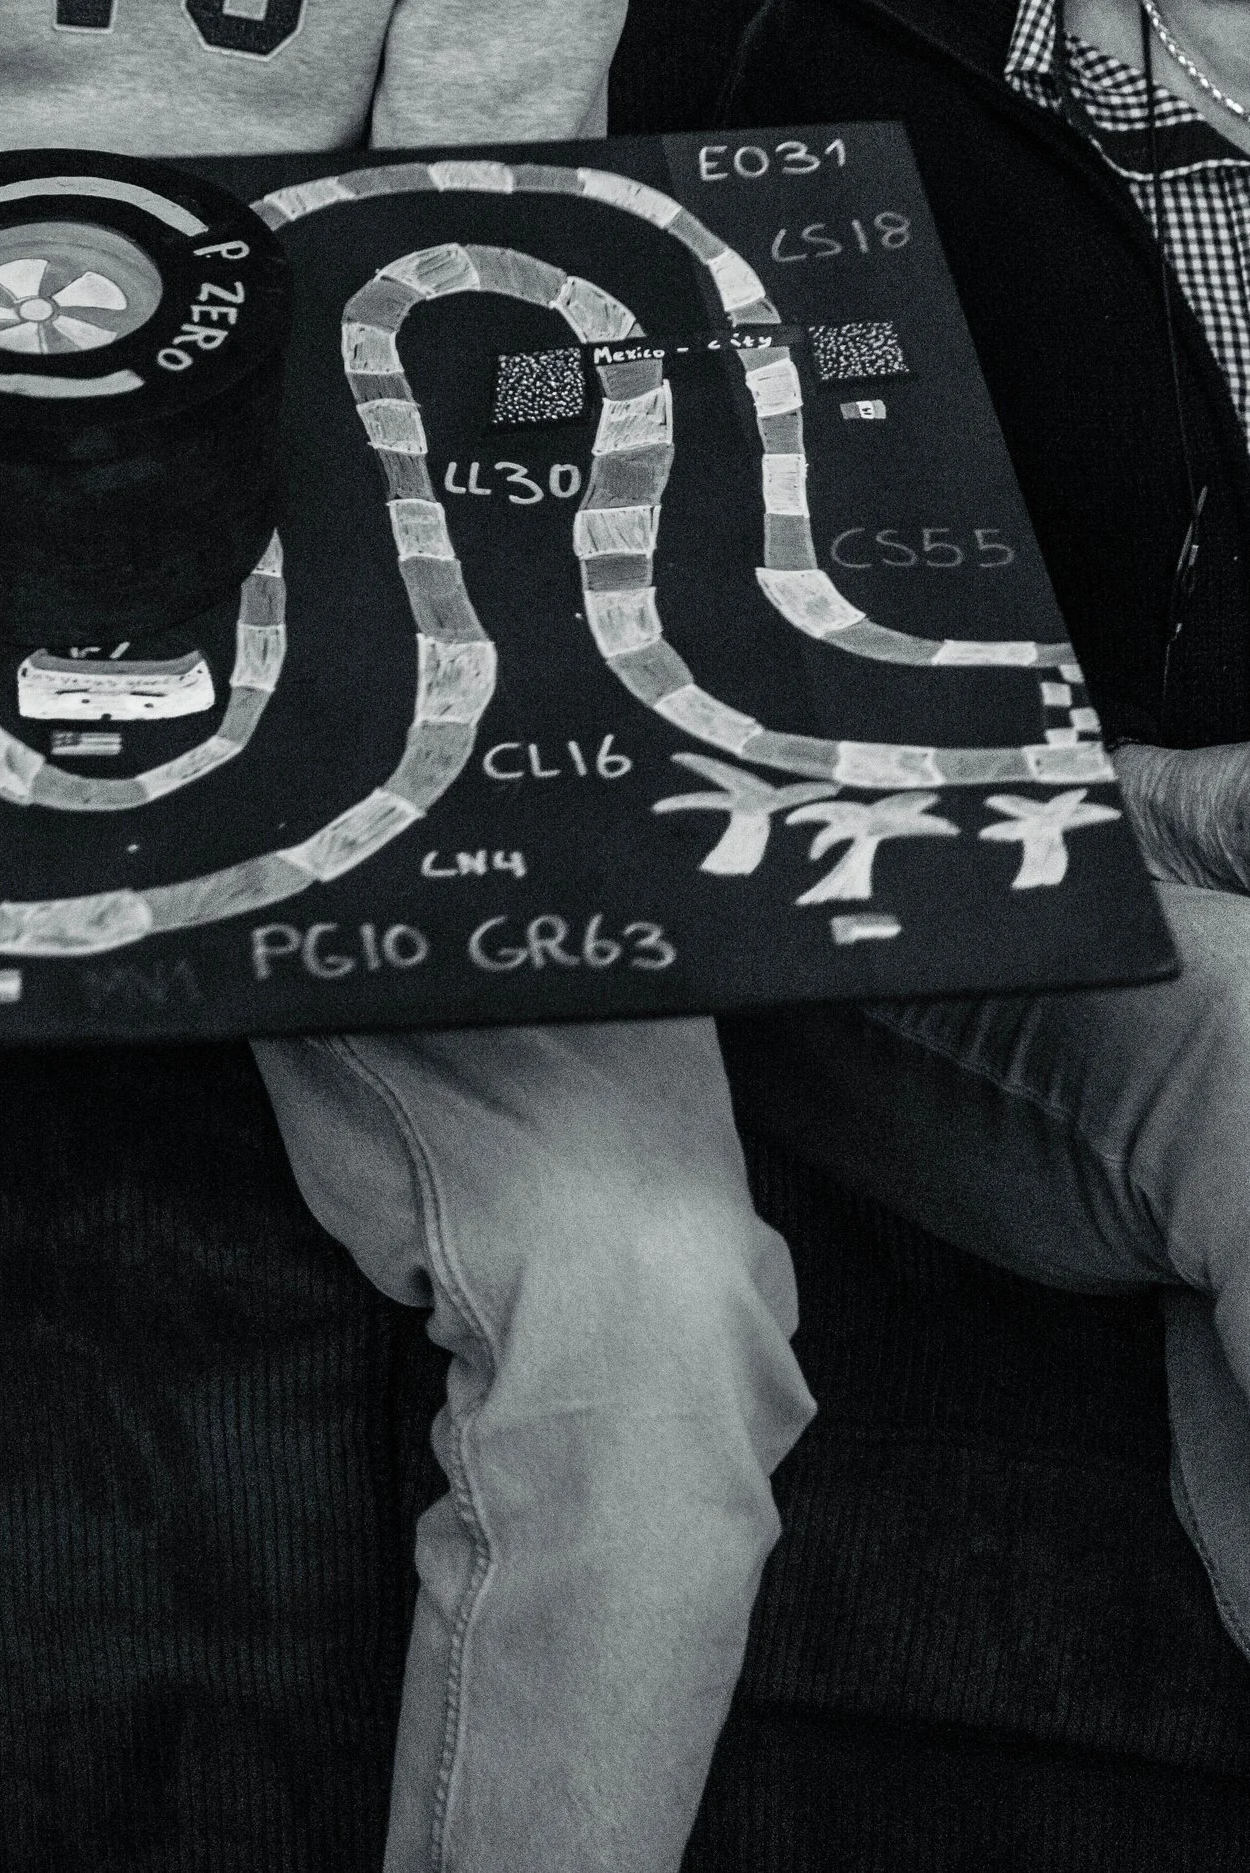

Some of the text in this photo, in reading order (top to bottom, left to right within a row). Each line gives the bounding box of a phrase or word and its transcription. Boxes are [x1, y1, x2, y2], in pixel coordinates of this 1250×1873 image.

[771, 211, 911, 262] LS18
[157, 240, 250, 371] P ZERO
[593, 345, 666, 364] Mexico
[444, 461, 582, 505] LL30
[830, 527, 1015, 568] CS55
[482, 734, 632, 779] CL16
[252, 923, 428, 980] PG10
[468, 914, 676, 971] GR63
